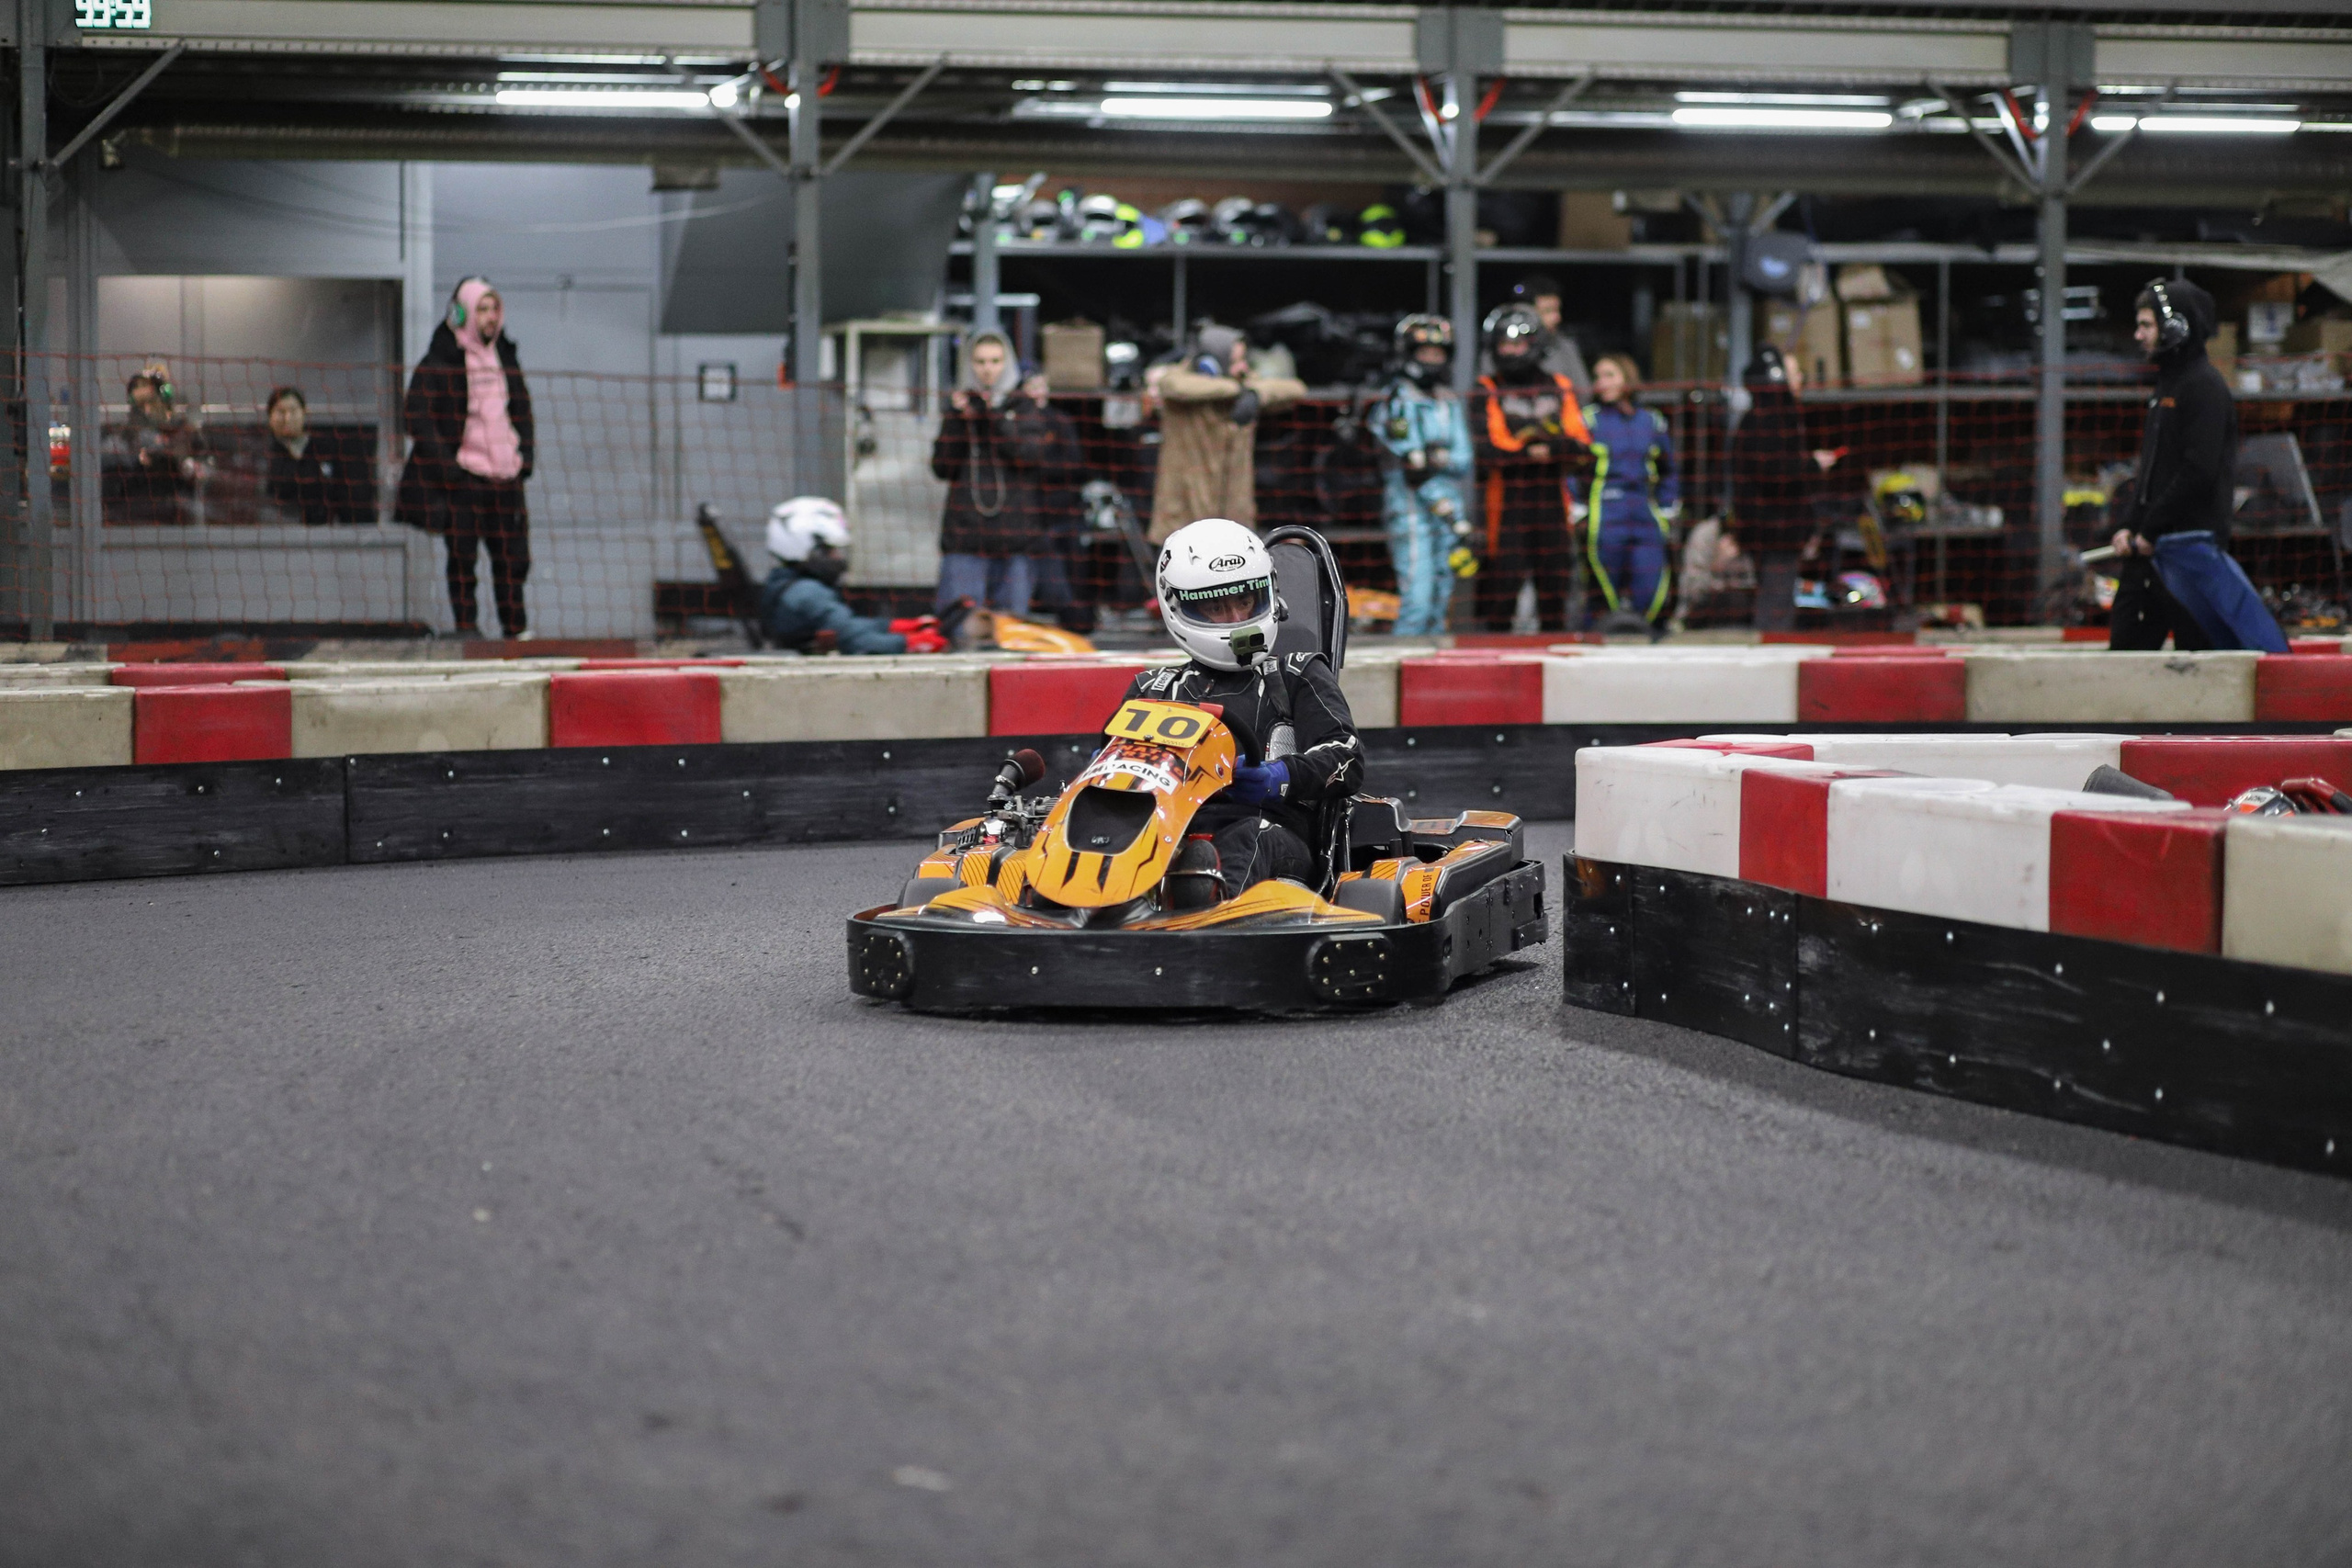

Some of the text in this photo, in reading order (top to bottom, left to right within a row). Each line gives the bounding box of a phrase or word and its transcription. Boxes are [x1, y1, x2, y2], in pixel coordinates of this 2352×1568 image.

[1213, 556, 1241, 569] Arai
[1179, 584, 1245, 601] Hammer
[1125, 708, 1201, 739] 10
[1105, 762, 1170, 787] ACING
[1420, 883, 1431, 916] POWER
